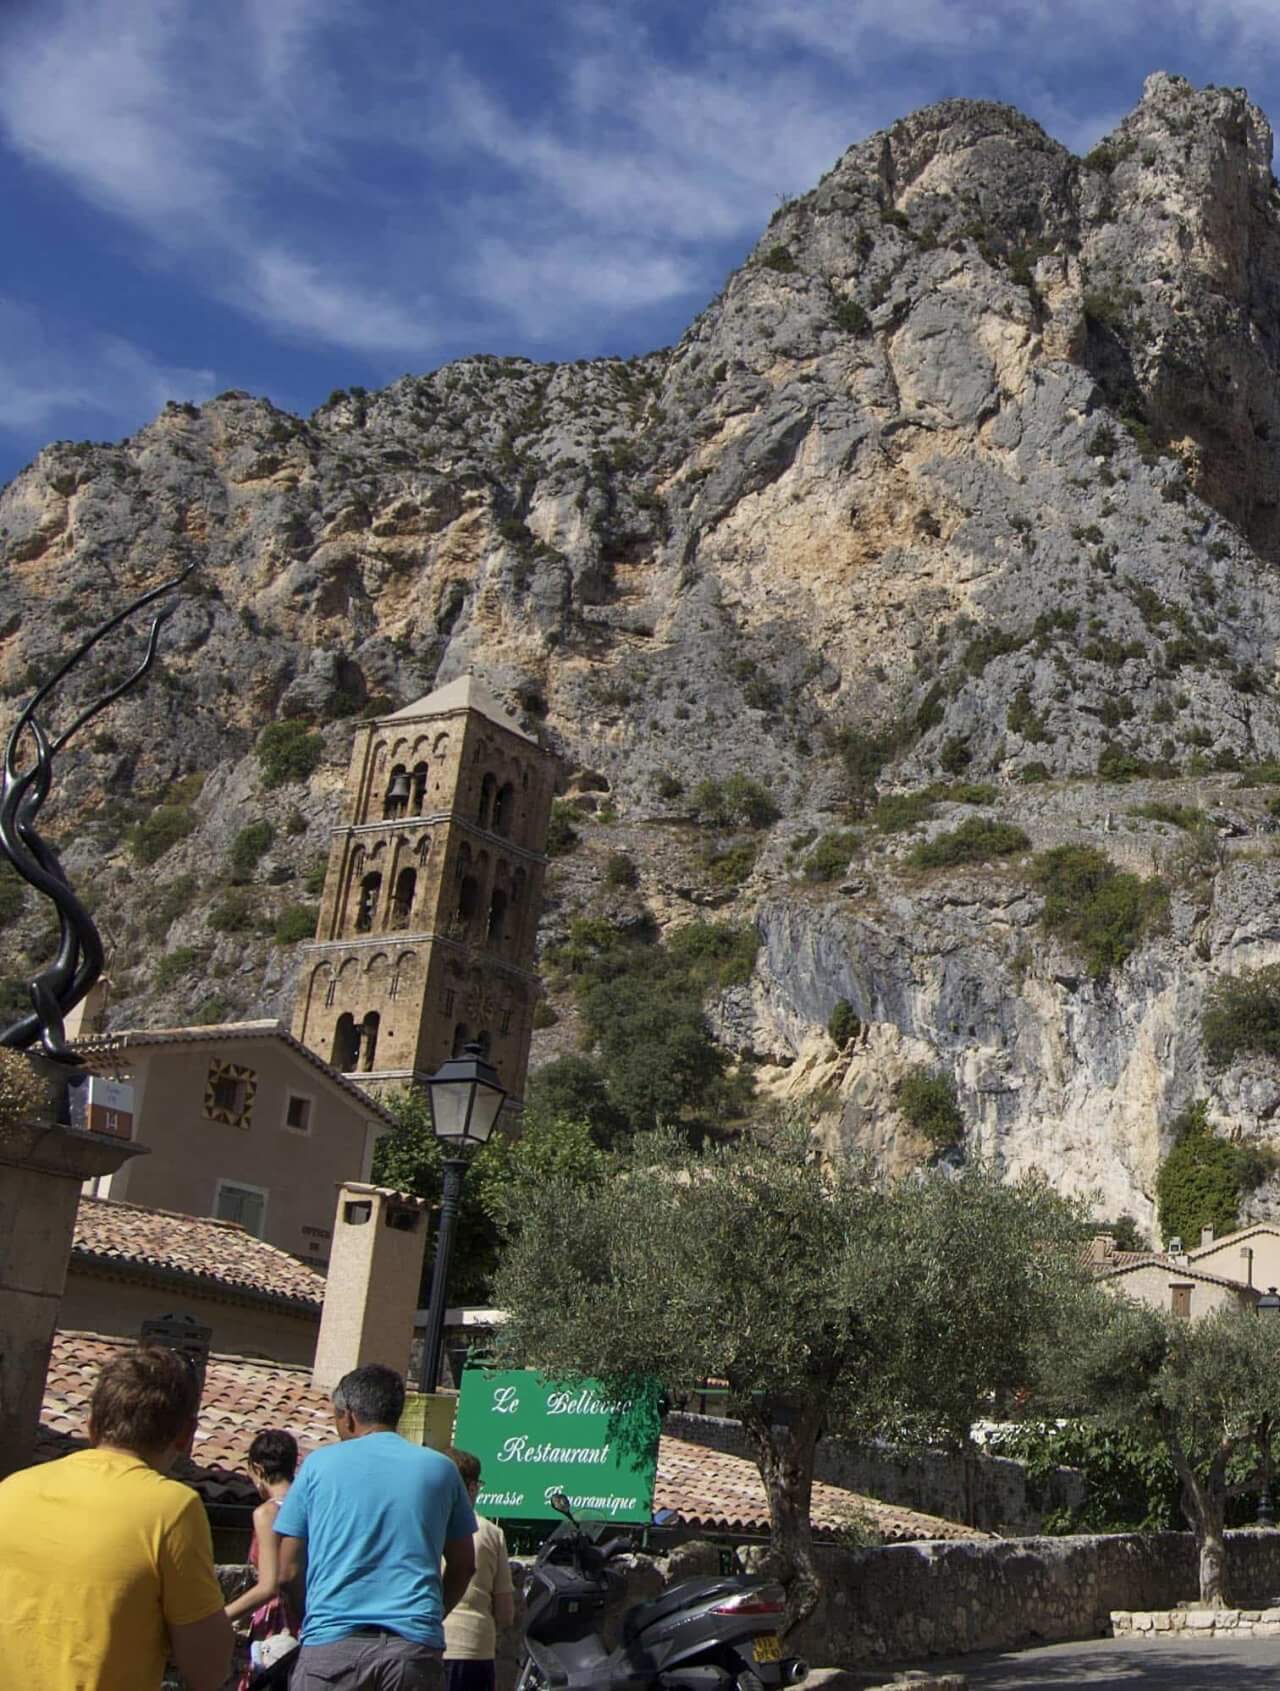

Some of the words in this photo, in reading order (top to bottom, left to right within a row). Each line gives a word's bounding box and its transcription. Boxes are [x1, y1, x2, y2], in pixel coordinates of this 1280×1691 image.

[491, 1386, 519, 1413] Le
[497, 1435, 610, 1464] Restaurant
[476, 1487, 524, 1506] errasse
[544, 1485, 637, 1516] Pnoramique
